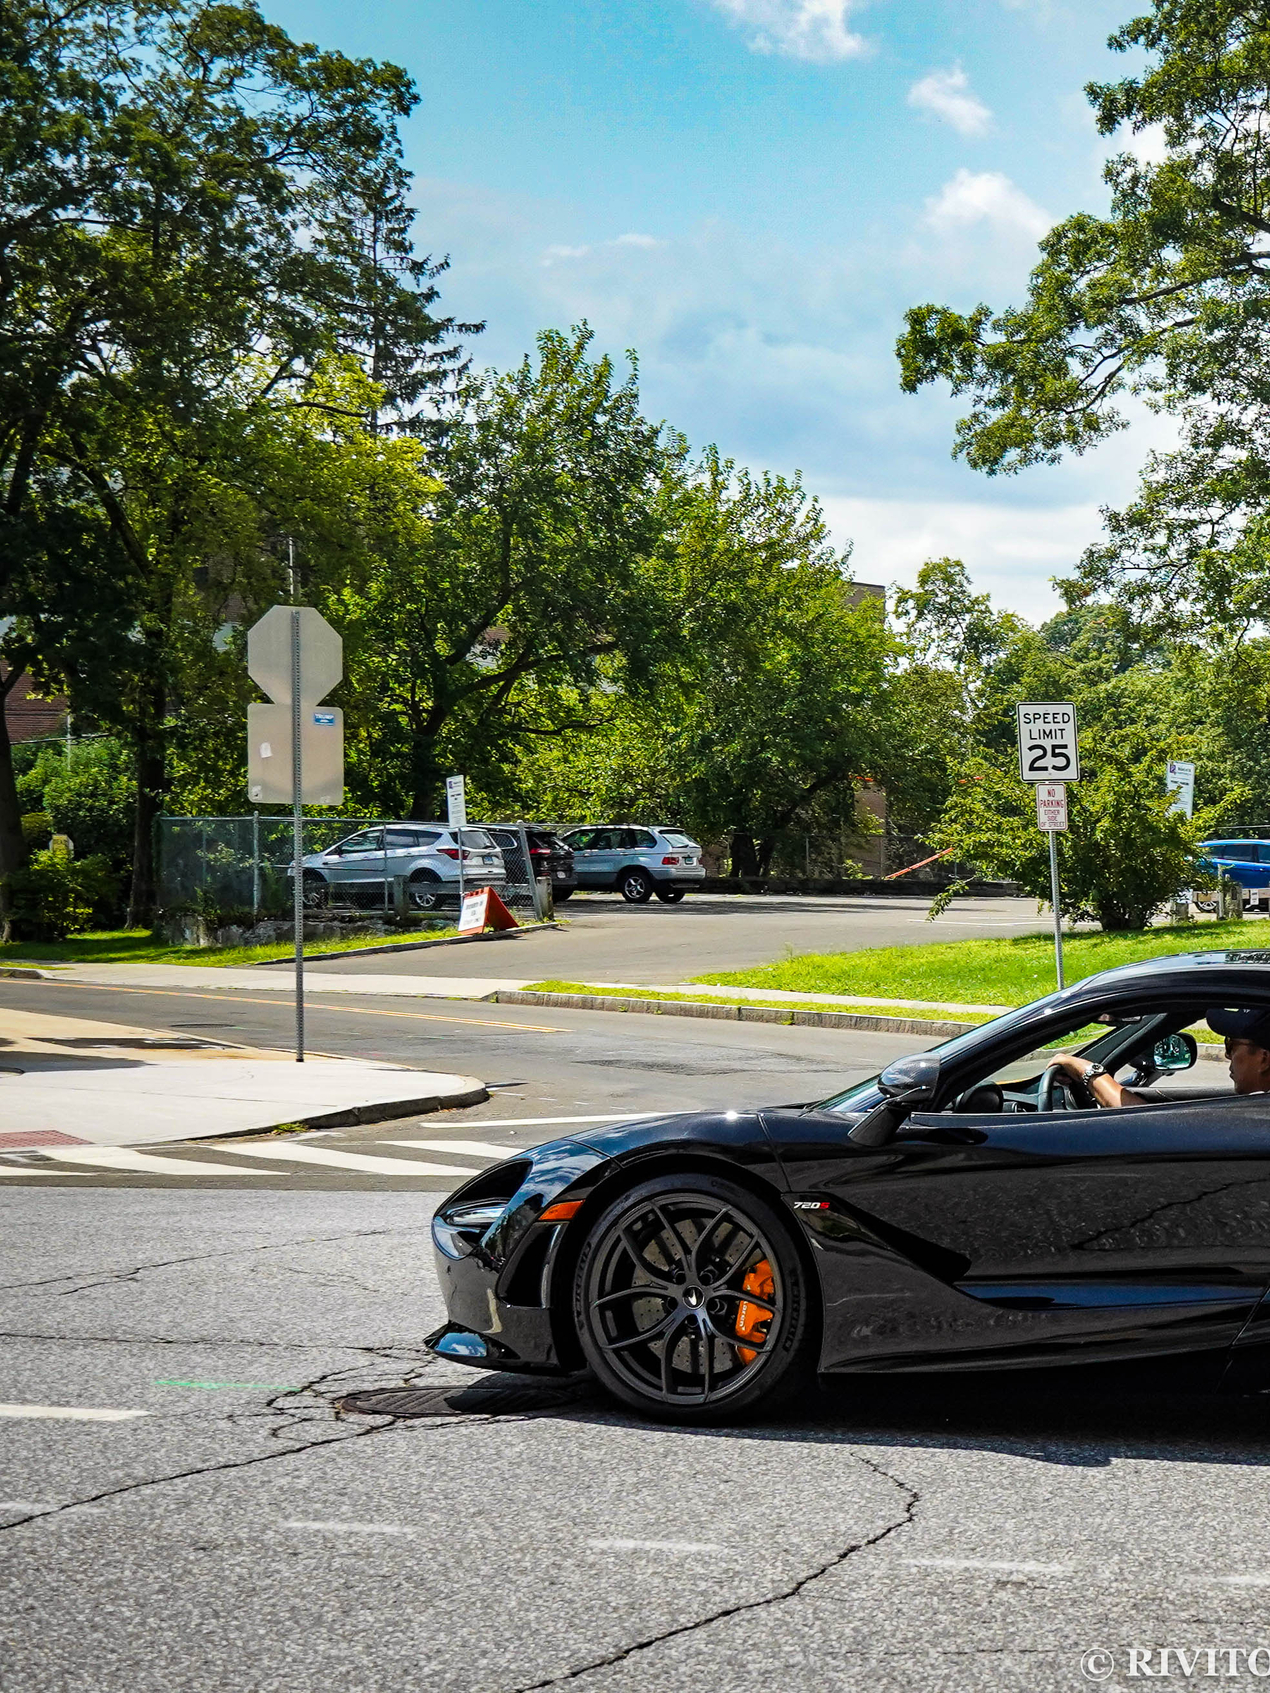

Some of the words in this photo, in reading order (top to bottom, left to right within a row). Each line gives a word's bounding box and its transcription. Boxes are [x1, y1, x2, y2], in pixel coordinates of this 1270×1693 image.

[1023, 712, 1071, 724] SPEED
[1029, 728, 1066, 740] LIMIT
[1027, 744, 1071, 772] 25
[1047, 788, 1056, 798] NO
[1040, 799, 1064, 809] PARKING
[793, 1201, 831, 1210] 720S
